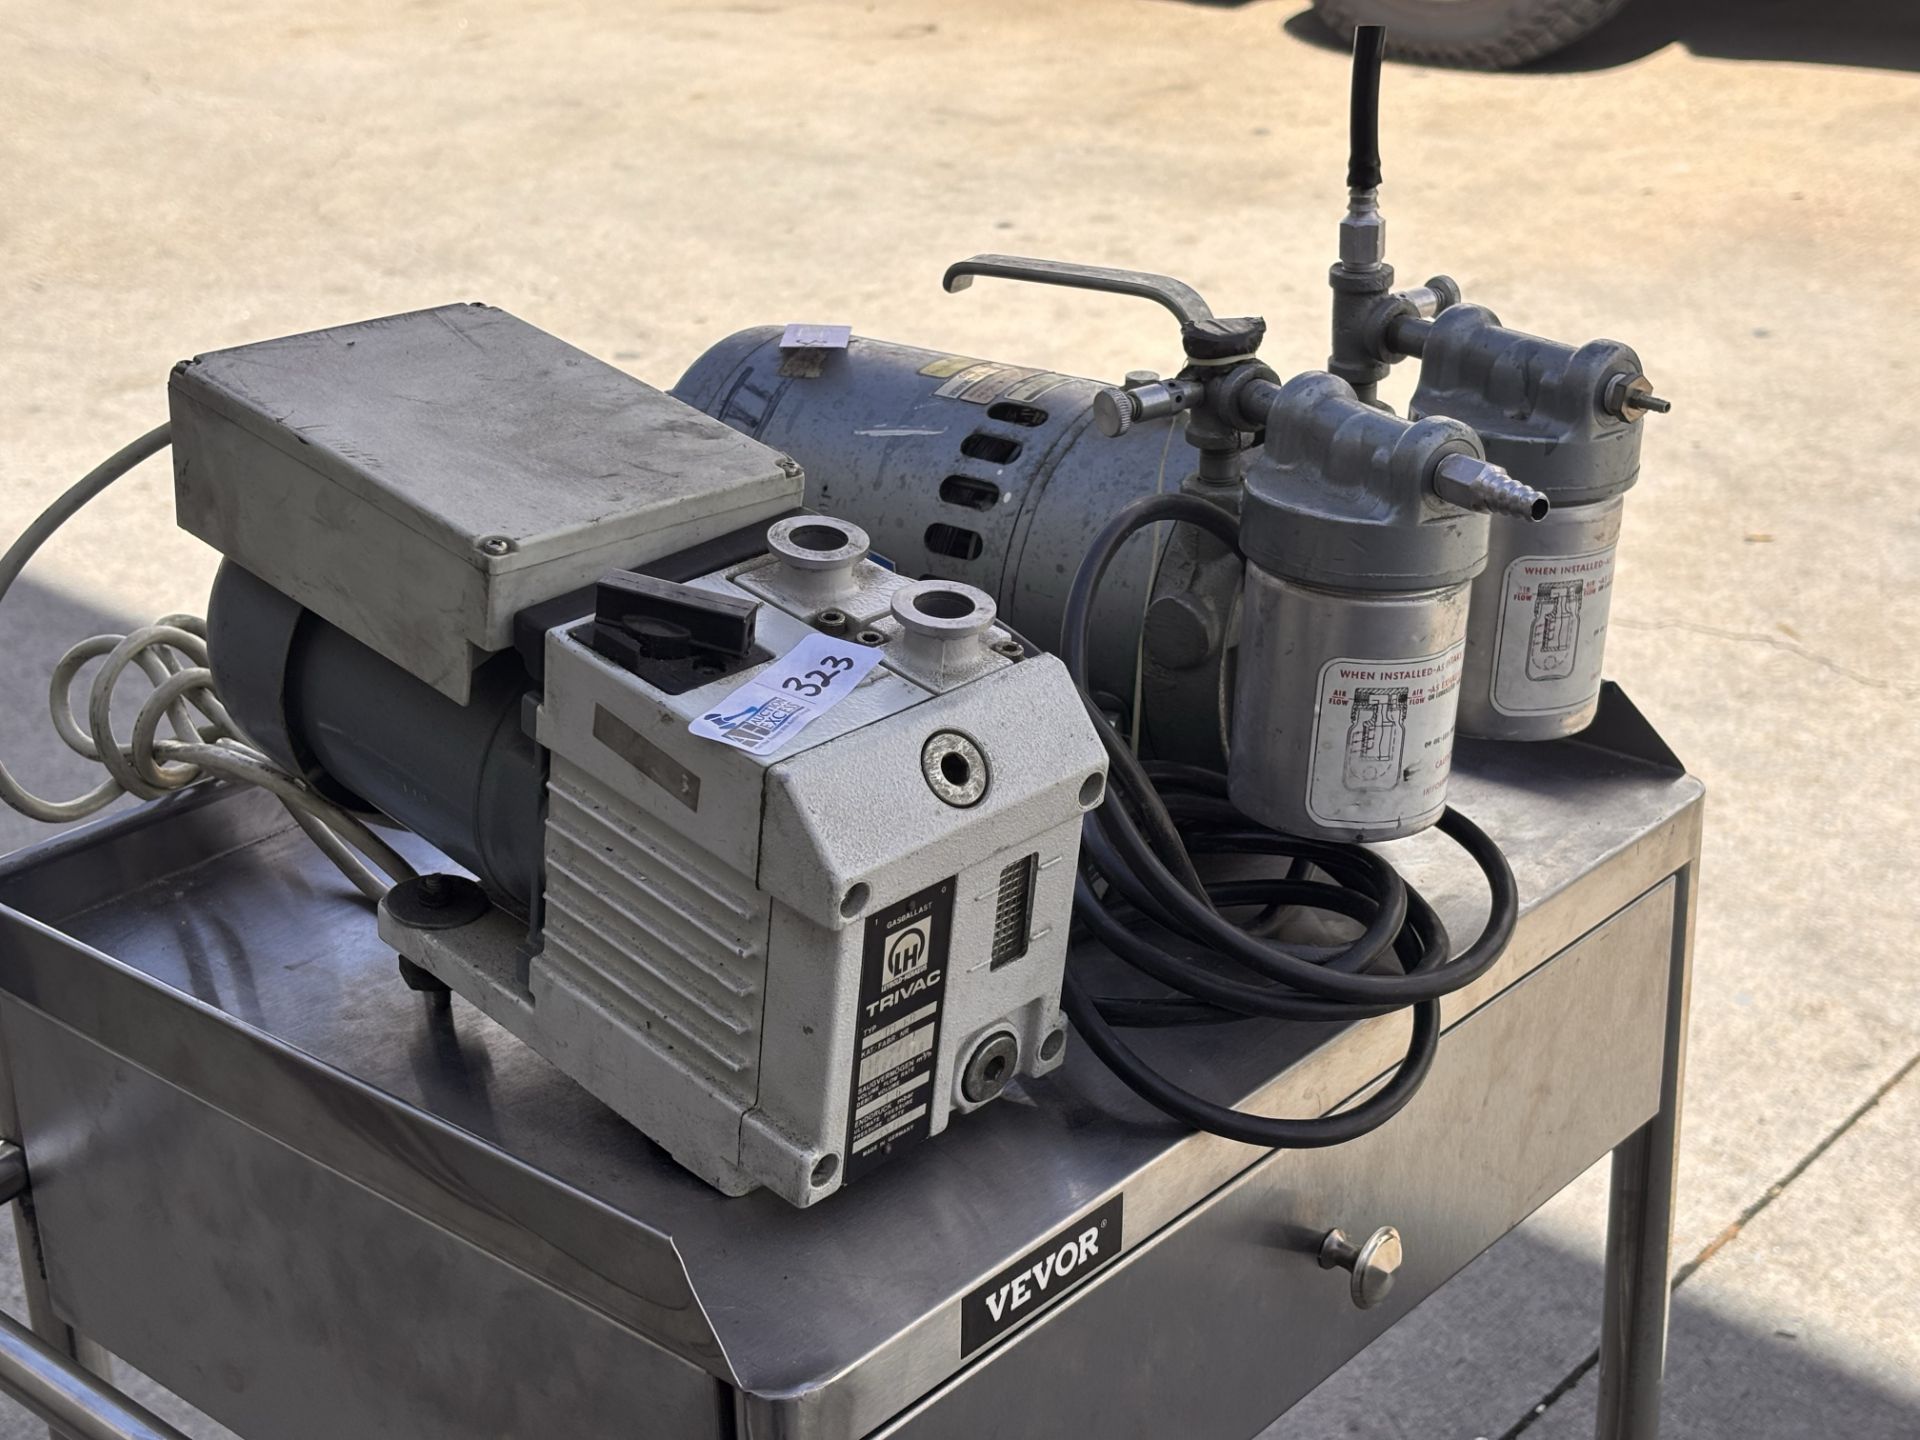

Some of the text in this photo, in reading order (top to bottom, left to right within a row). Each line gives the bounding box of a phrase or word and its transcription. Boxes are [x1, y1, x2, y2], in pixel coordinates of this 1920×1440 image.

[1524, 566, 1556, 575] WHEN
[782, 655, 854, 697] 323
[1340, 669, 1376, 680] WHEN
[1328, 698, 1350, 706] FLOW
[1333, 689, 1347, 697] AIR
[1409, 697, 1425, 706] FLOW
[750, 698, 787, 725] AUCTION
[760, 702, 800, 730] EXCESS
[886, 901, 933, 929] GASBALLAST
[866, 969, 940, 1018] TRIVAC
[863, 1024, 877, 1037] TYP
[858, 1086, 880, 1100] VOLUME
[883, 1076, 898, 1086] FLOW
[900, 1066, 915, 1078] RATE
[854, 1103, 892, 1128] ENDDRUCK
[986, 1227, 1099, 1322] VEVOR
